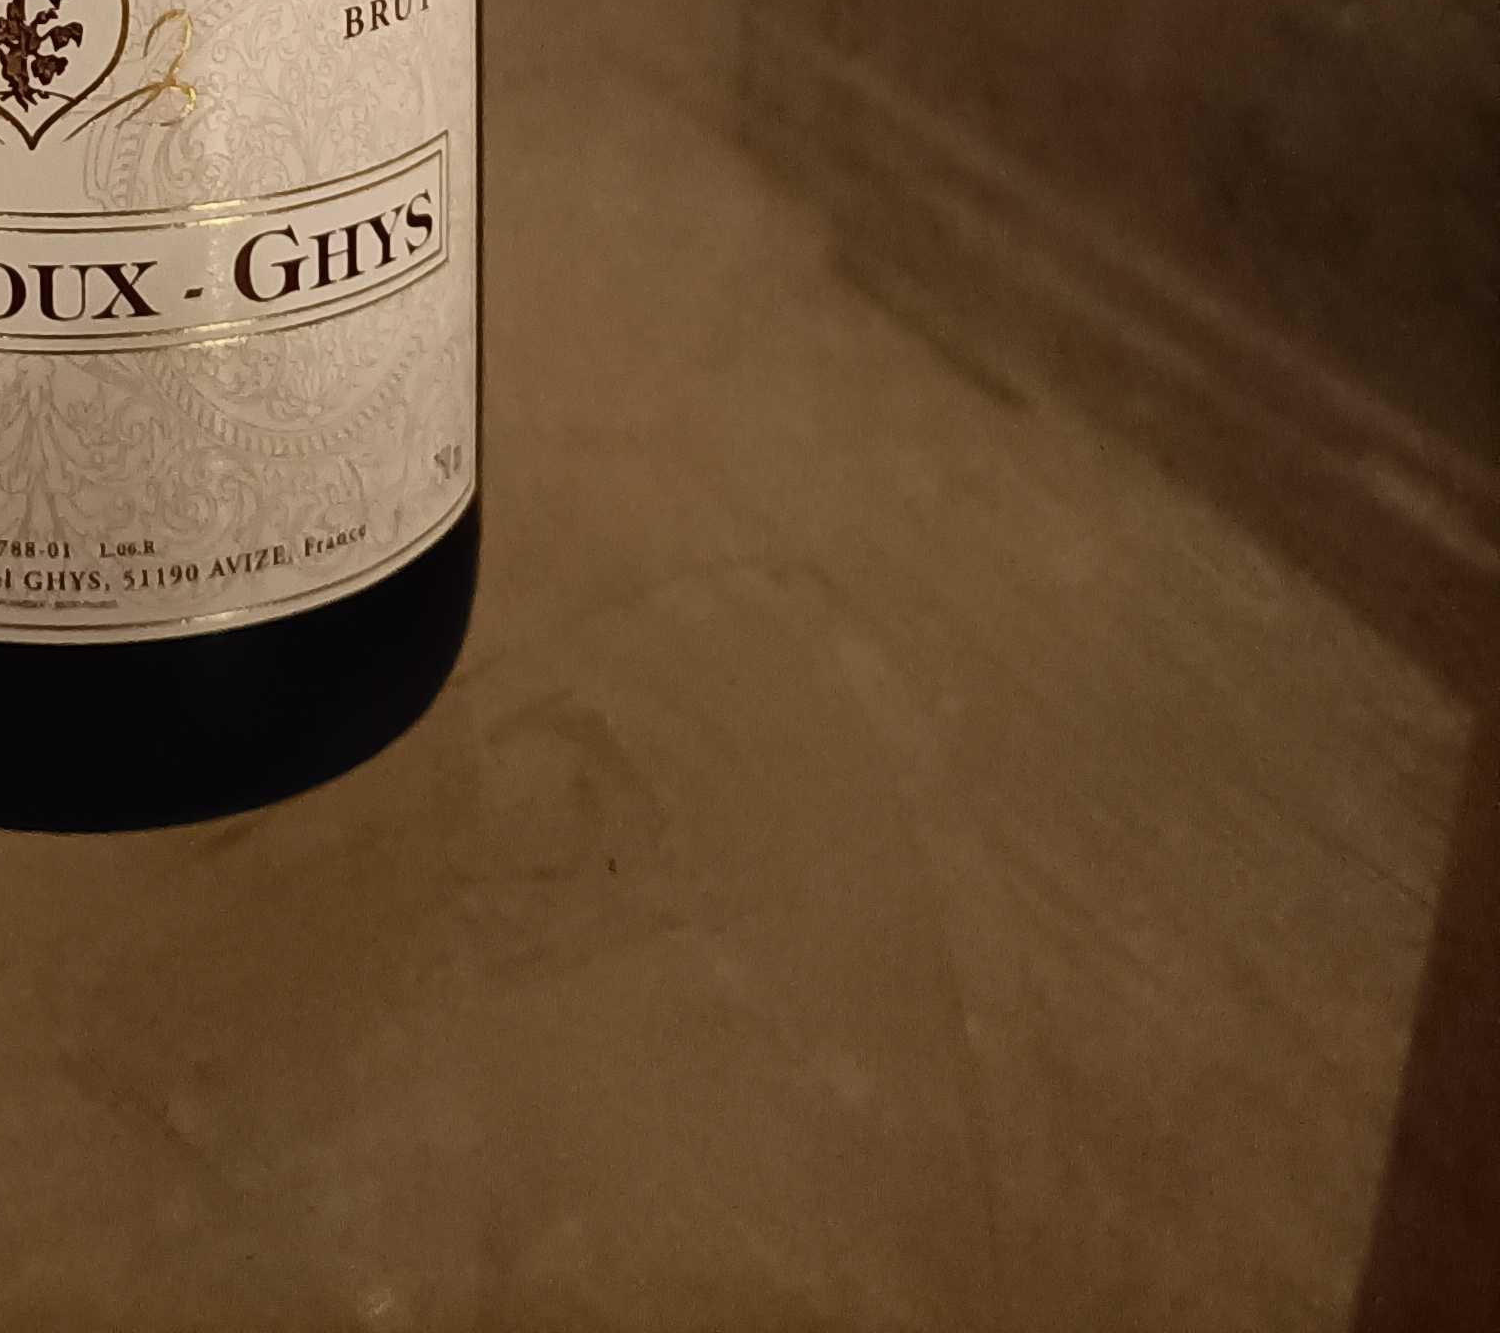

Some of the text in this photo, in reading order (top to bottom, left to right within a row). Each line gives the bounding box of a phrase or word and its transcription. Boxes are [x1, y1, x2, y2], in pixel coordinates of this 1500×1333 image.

[233, 188, 434, 303] GHYS
[23, 570, 111, 593] GHYS,
[122, 563, 199, 591] 51190
[304, 523, 368, 558] France
